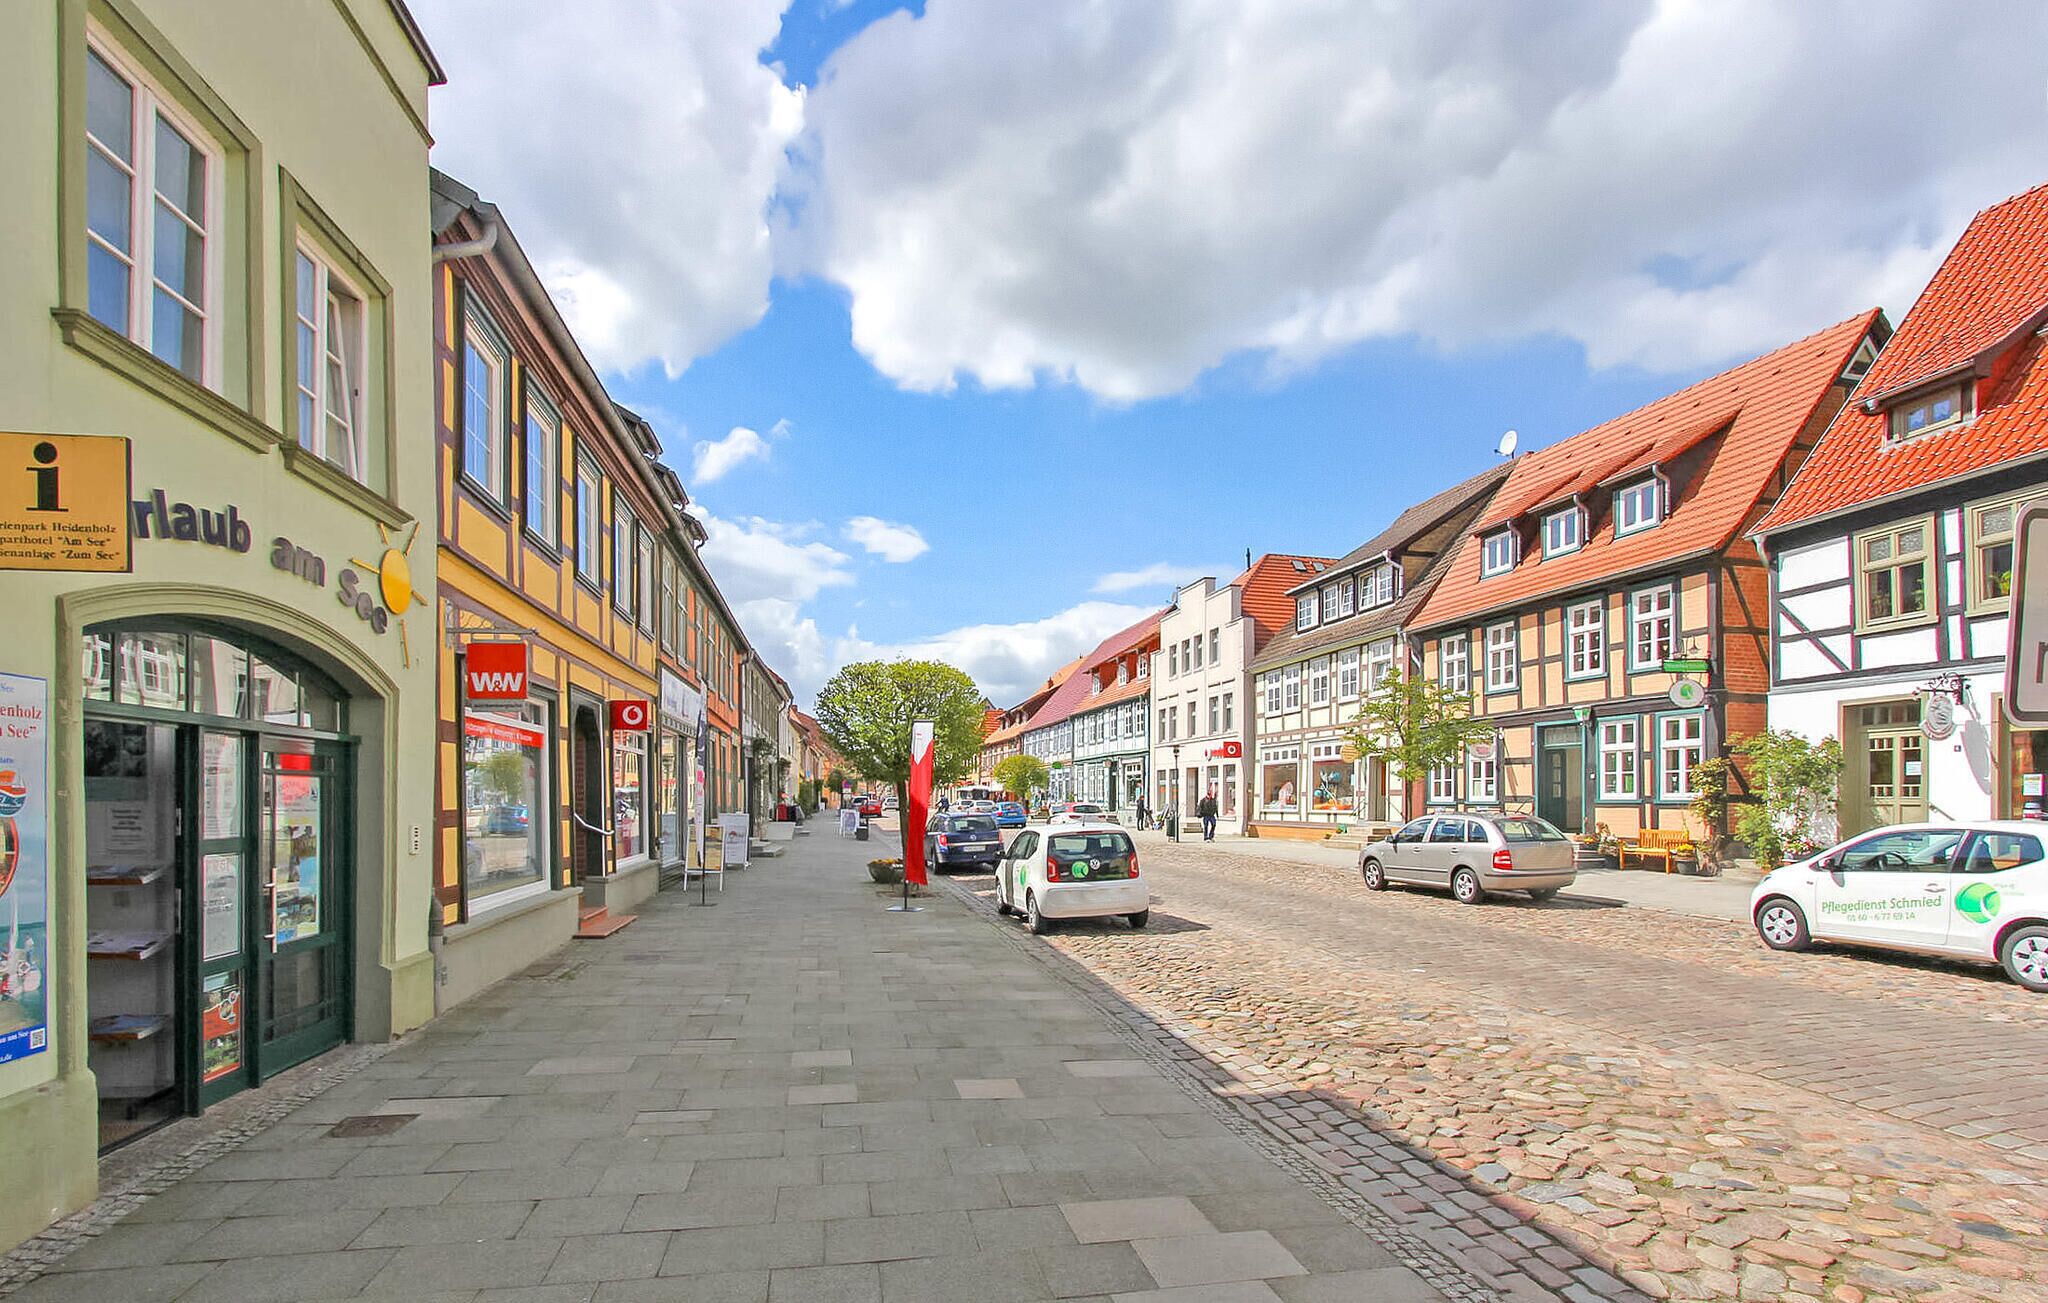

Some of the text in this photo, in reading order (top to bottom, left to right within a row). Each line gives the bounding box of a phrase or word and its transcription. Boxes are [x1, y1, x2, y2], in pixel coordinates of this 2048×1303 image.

[52, 522, 117, 533] Heidenholz
[270, 536, 325, 587] am
[337, 569, 388, 634] See
[470, 672, 524, 692] W&W
[1822, 895, 1942, 914] Pflegedienst Schmied
